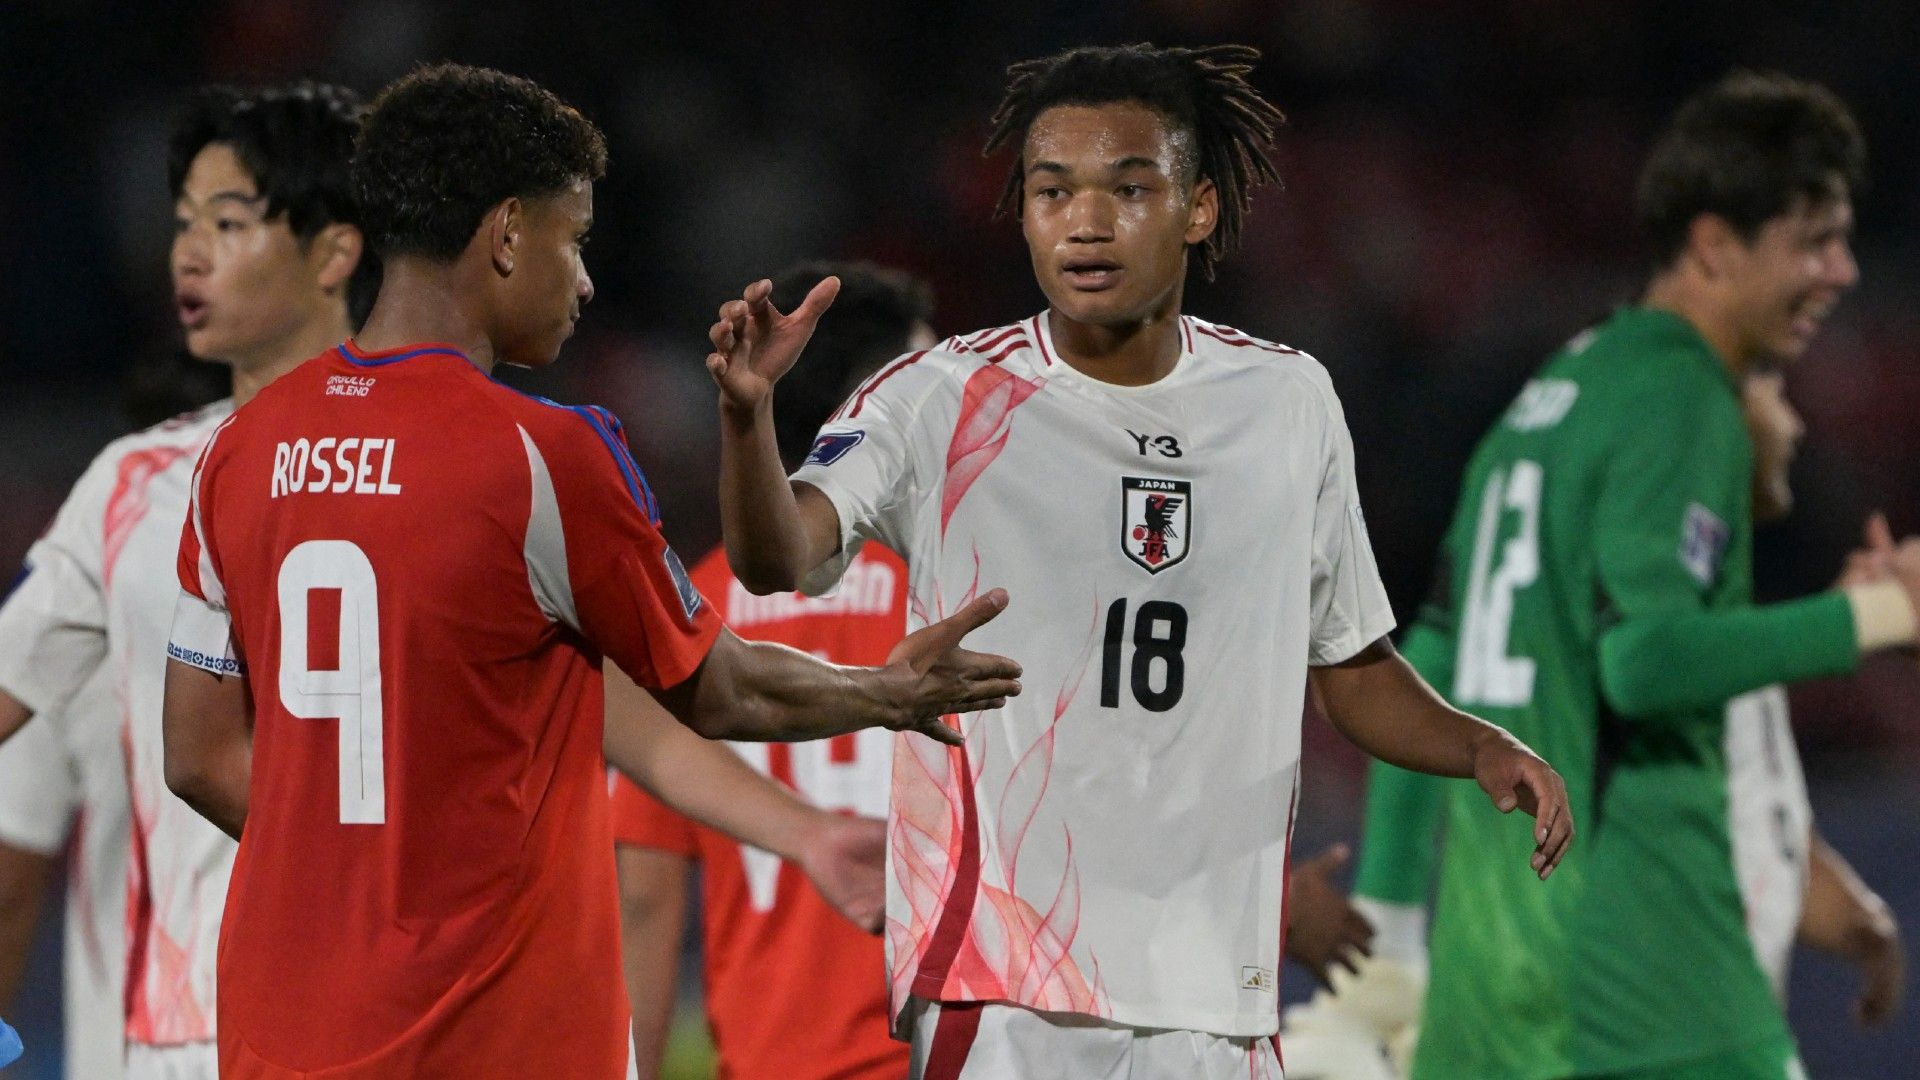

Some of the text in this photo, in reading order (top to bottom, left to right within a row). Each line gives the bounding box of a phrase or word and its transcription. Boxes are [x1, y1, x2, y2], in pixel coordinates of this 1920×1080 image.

[325, 384, 369, 397] CHILENO
[326, 375, 376, 387] ORGULLO
[1124, 428, 1184, 459] Y-3
[271, 436, 402, 499] ROSSEL
[1137, 478, 1177, 491] JAPAN
[1138, 540, 1170, 560] JFA
[1100, 596, 1189, 713] 18
[278, 540, 386, 825] 9
